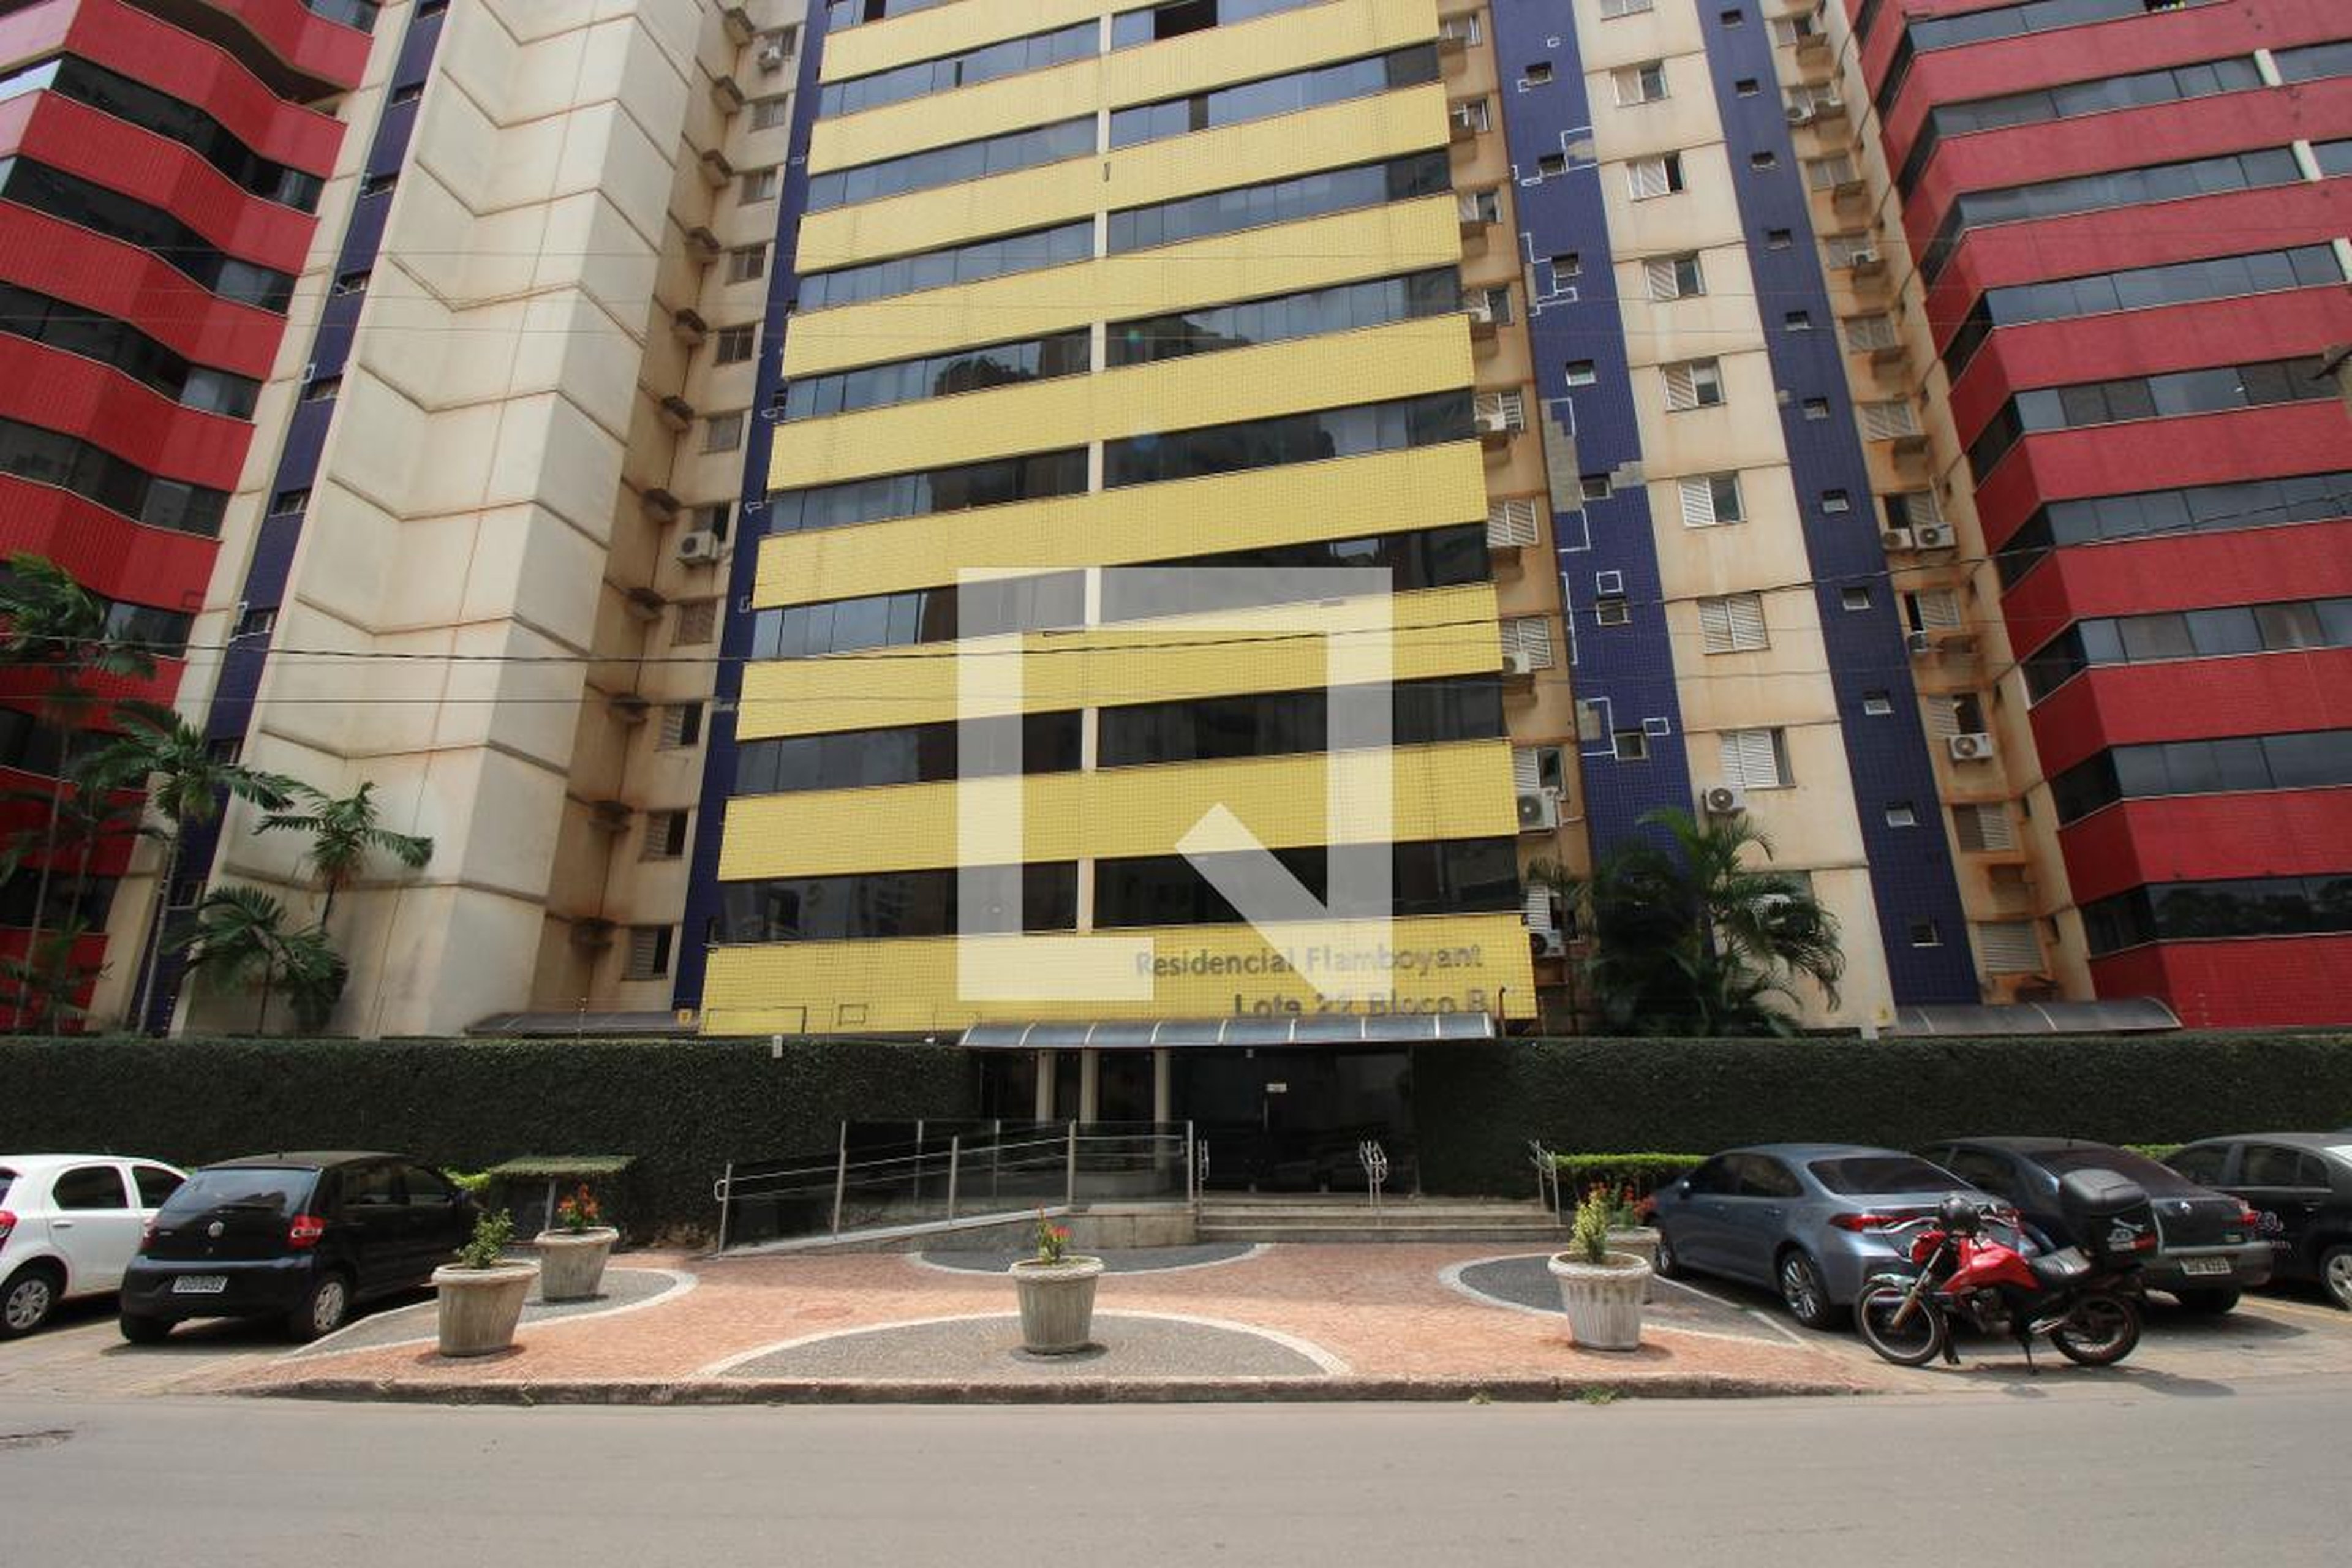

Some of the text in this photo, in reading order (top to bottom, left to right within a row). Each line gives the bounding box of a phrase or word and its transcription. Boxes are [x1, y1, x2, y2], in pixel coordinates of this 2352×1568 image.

[1136, 944, 1483, 977] Residencial Flamboyant
[1234, 993, 1303, 1016] Lote
[1370, 989, 1457, 1015] Bloco
